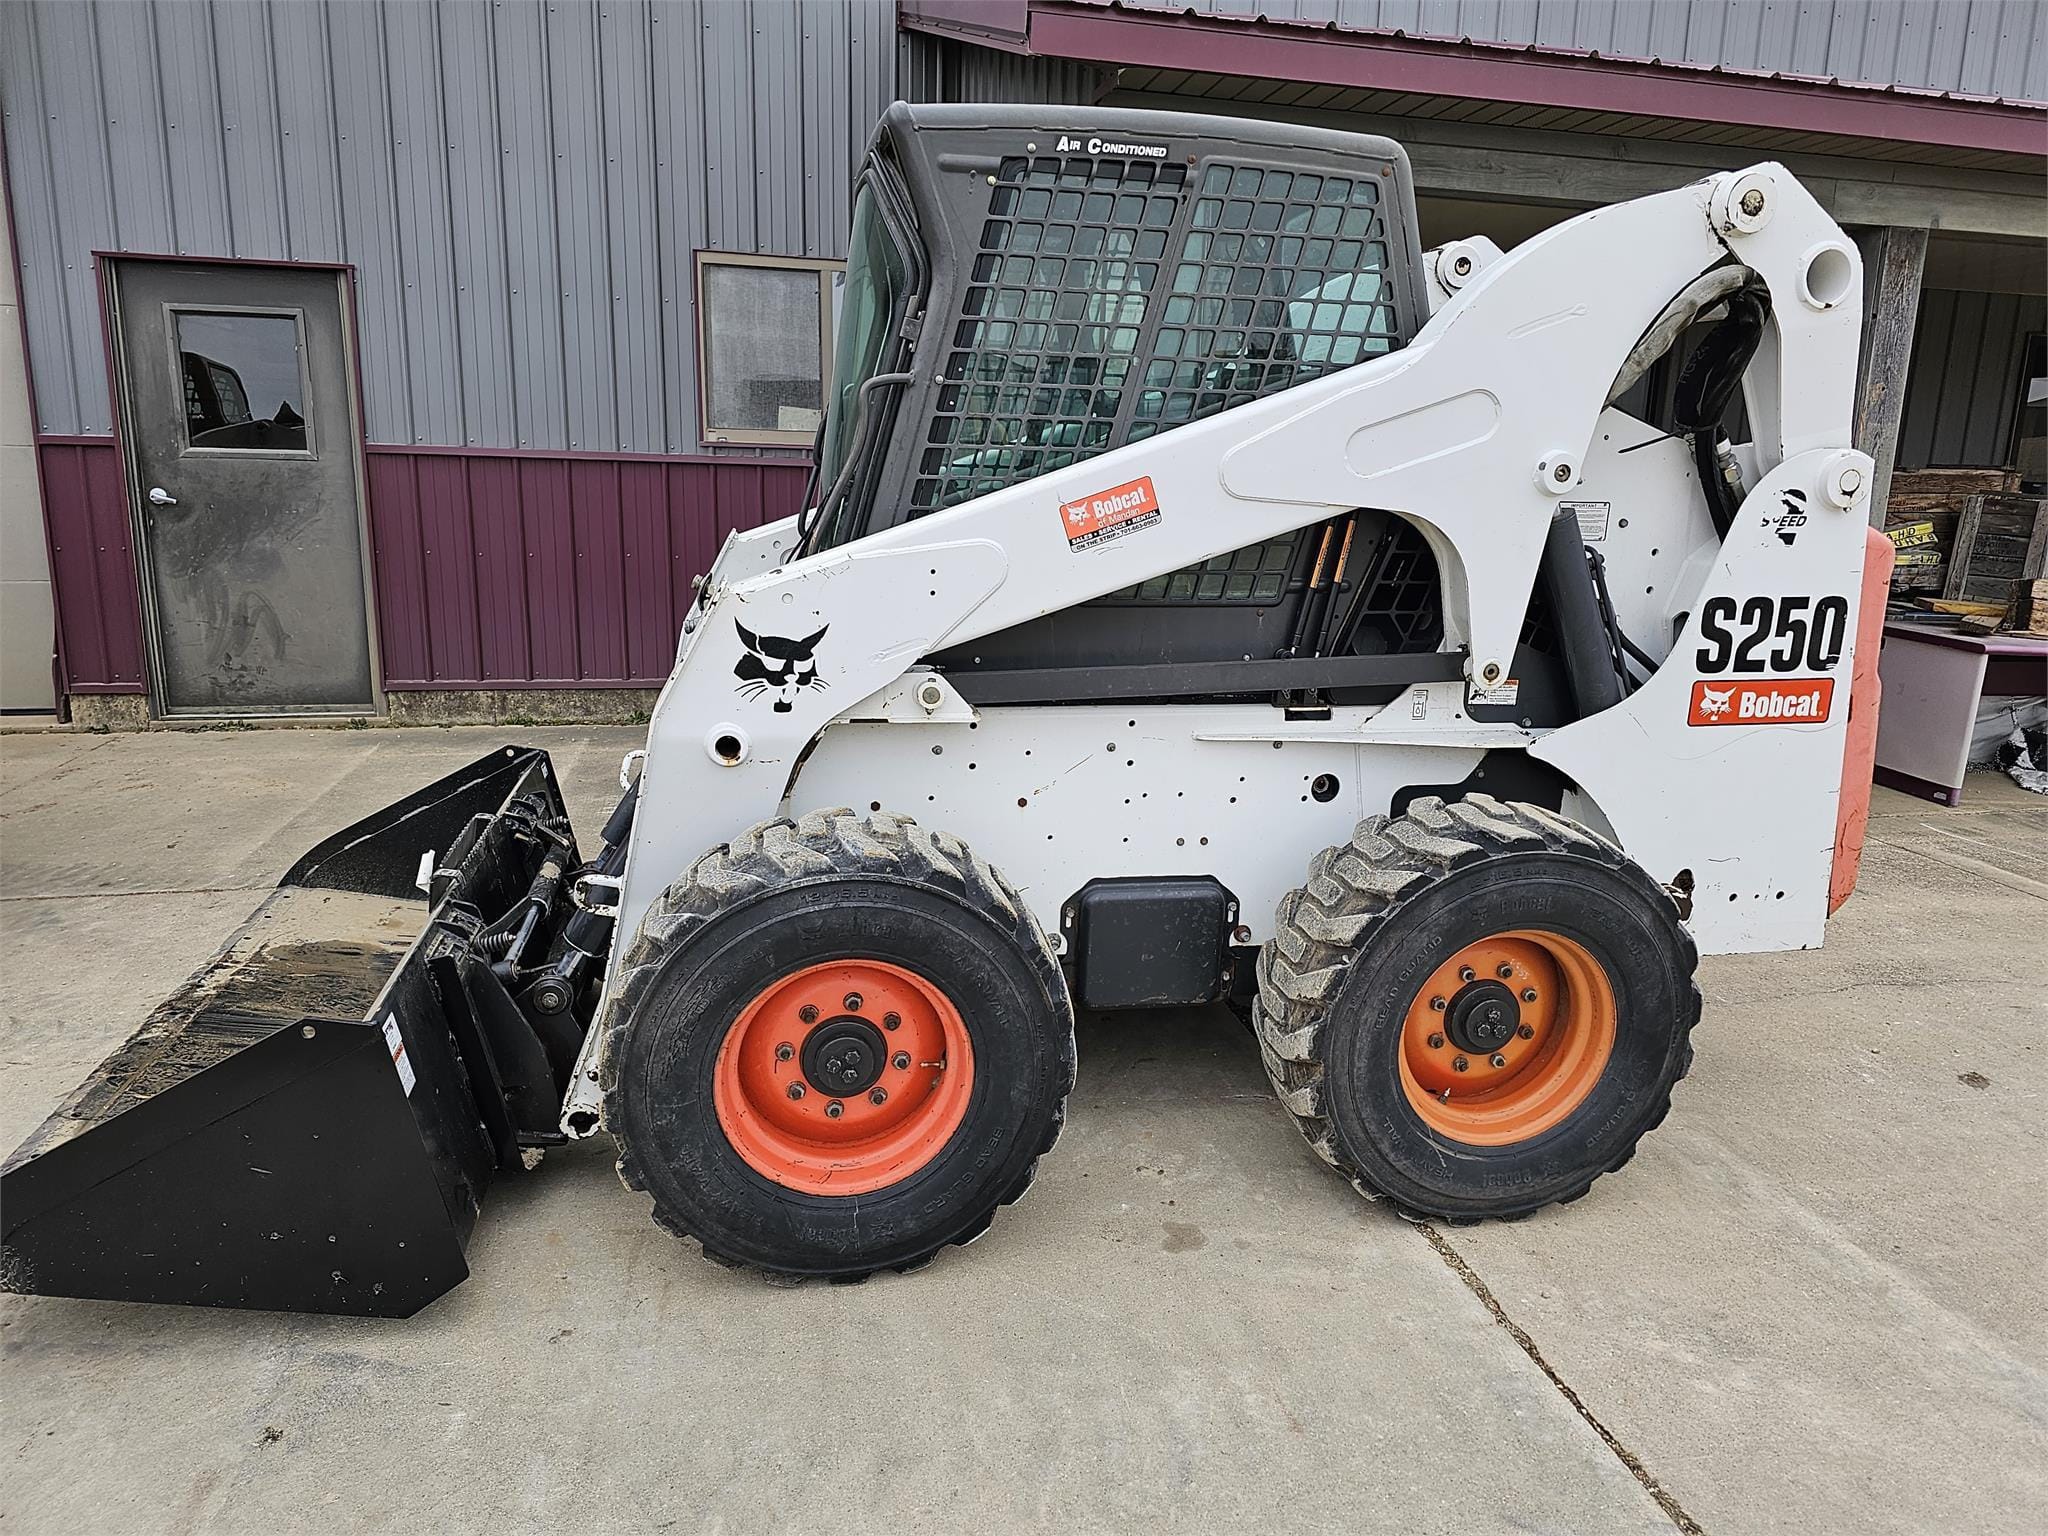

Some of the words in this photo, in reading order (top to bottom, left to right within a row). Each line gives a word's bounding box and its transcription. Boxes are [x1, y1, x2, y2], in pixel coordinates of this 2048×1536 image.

[1056, 135, 1082, 152] AIR
[1088, 137, 1167, 158] CONDITIONED
[1092, 486, 1147, 519] Bobcat
[1132, 510, 1159, 524] RENTAL
[1087, 537, 1099, 547] THE
[1098, 532, 1117, 543] STRIP
[1695, 595, 1849, 675] S250
[1738, 690, 1821, 719] Bobcat
